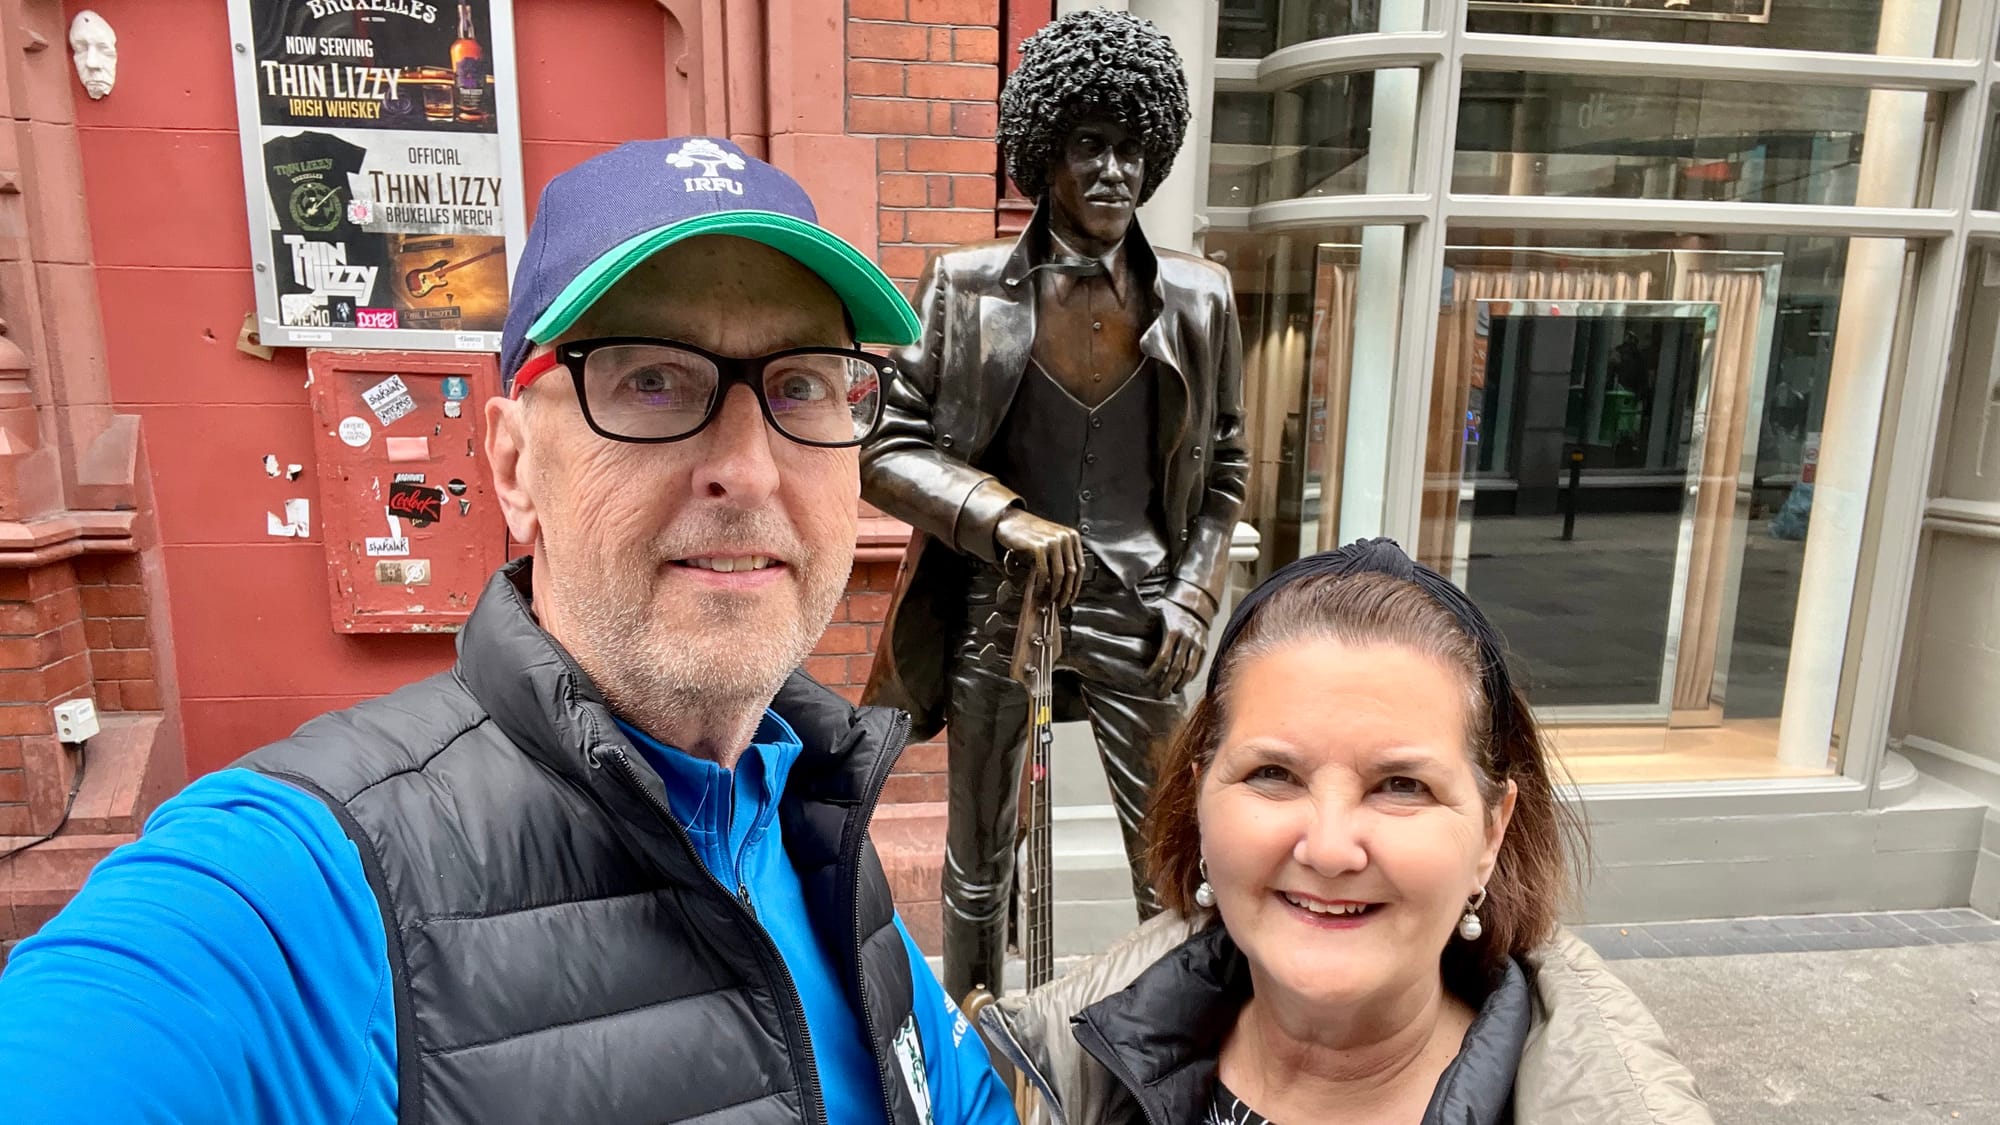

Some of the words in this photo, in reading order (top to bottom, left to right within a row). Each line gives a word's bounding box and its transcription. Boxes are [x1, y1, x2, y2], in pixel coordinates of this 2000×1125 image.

[306, 0, 437, 23] BRUXELLES
[286, 36, 316, 56] NOW
[320, 38, 374, 58] SERVING
[261, 60, 327, 97] THIN
[331, 65, 401, 100] LIZZY
[289, 98, 324, 117] IRISH
[326, 100, 381, 119] WHISKEY
[408, 147, 462, 166] OFFICIAL
[369, 171, 428, 204] THIN
[438, 172, 502, 207] LIZZY
[684, 178, 744, 195] IRFU
[386, 207, 450, 225] BRUXELLES
[453, 208, 493, 226] MERCH
